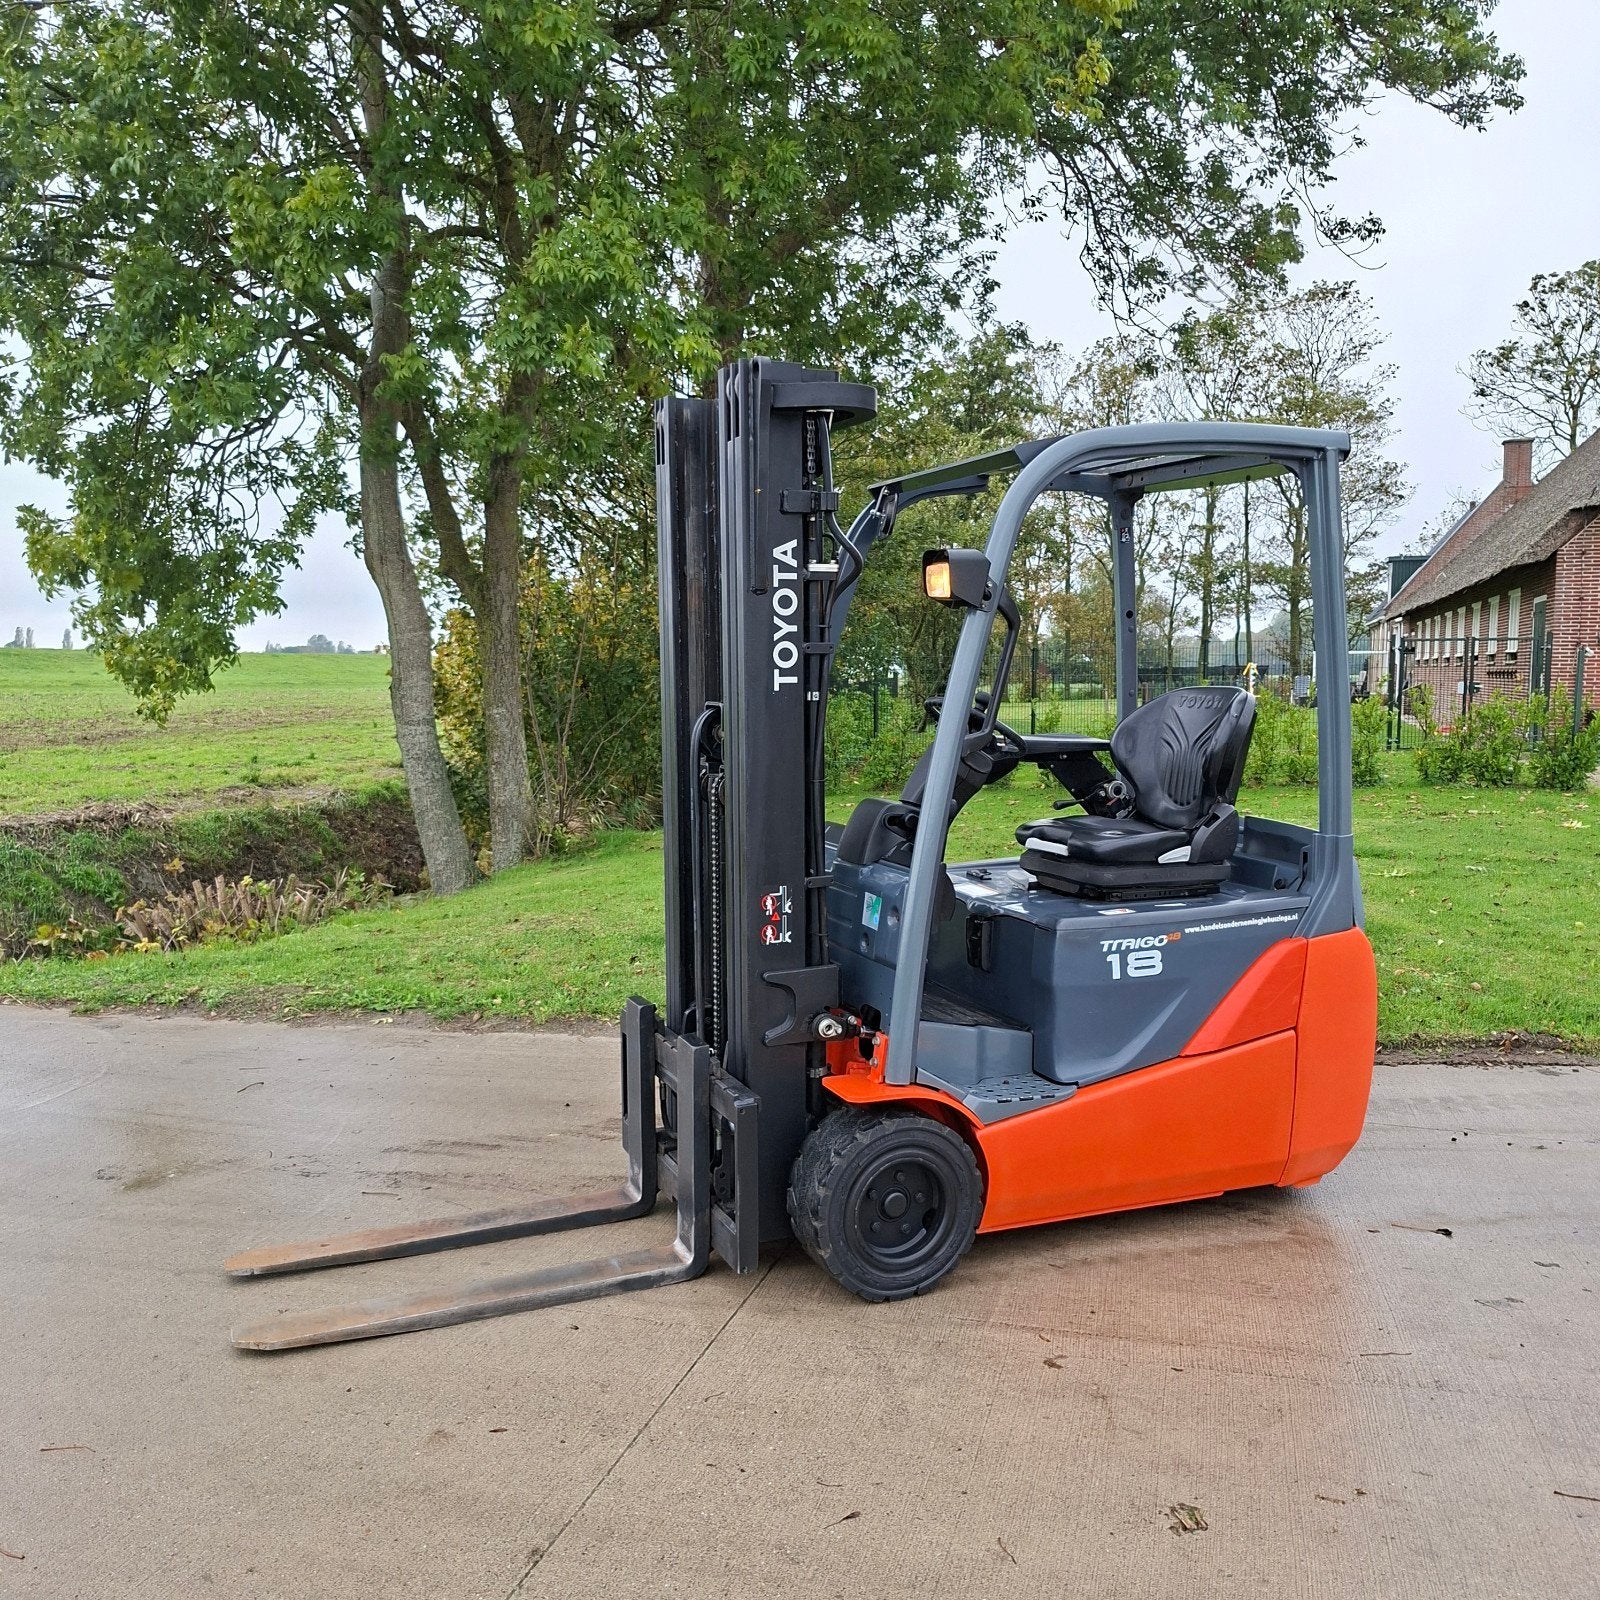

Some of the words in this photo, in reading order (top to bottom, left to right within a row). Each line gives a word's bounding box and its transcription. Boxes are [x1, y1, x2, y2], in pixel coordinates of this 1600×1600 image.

[772, 538, 799, 692] TOYOTA
[1179, 694, 1224, 710] TOYOT
[1106, 949, 1163, 980] 18
